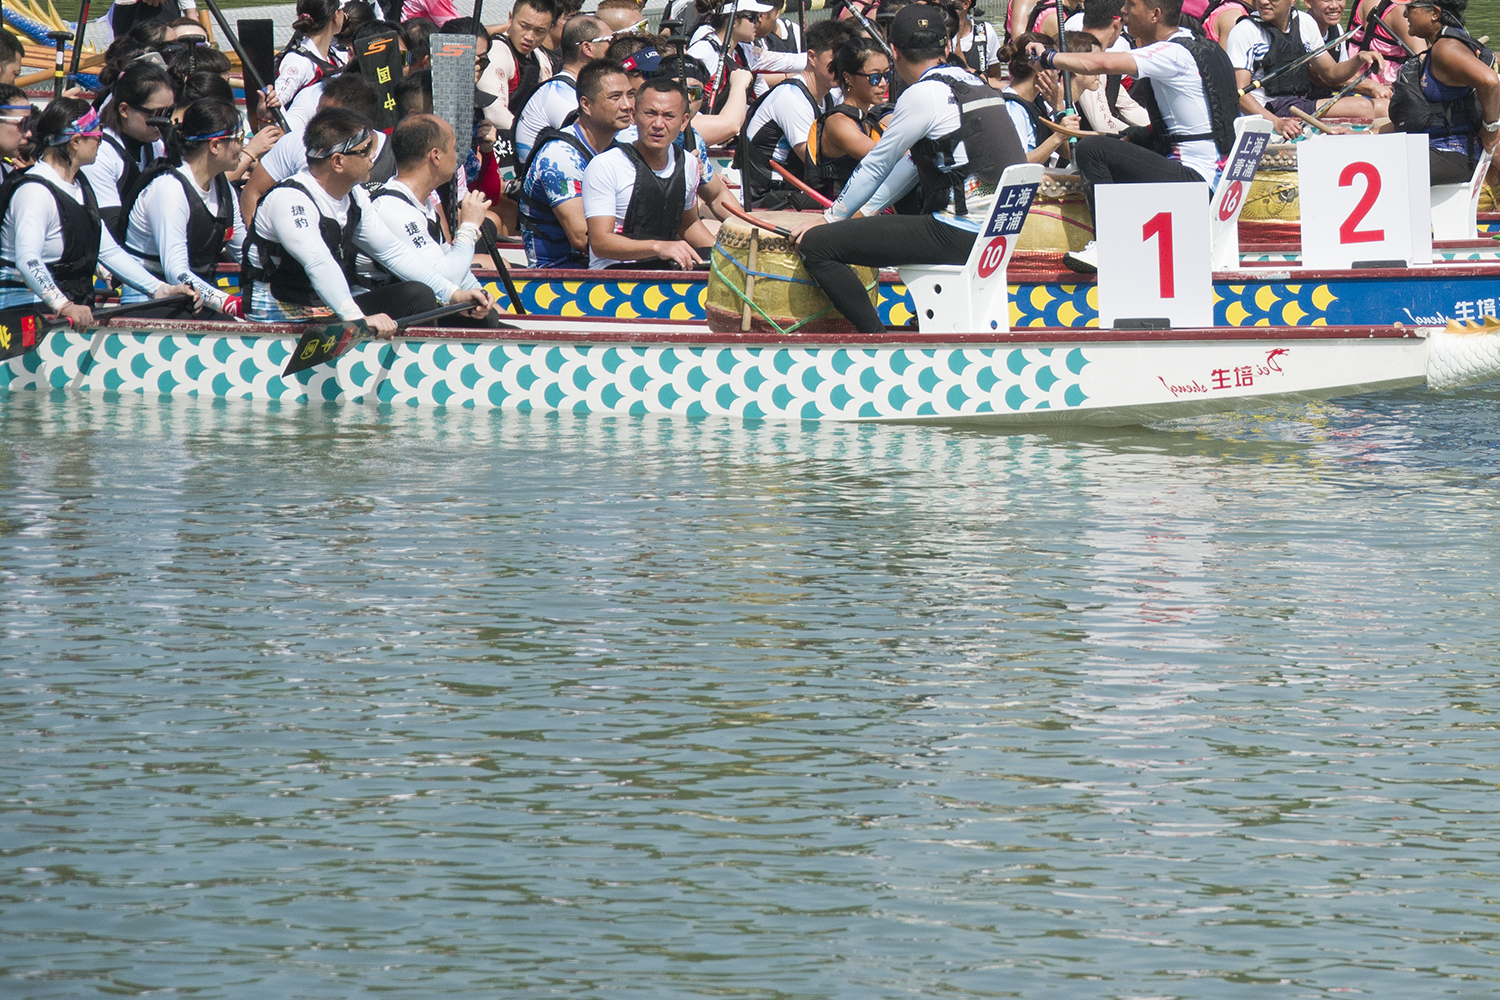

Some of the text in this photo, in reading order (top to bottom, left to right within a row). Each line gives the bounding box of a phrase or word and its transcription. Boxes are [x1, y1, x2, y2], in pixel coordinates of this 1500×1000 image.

[1240, 136, 1265, 156] 上海
[1000, 187, 1033, 209] 上海
[1222, 190, 1239, 212] 16
[1338, 161, 1385, 245] 2
[291, 205, 309, 229] 捷豹
[992, 211, 1024, 233] 青浦
[405, 221, 427, 249] 捷豹
[982, 245, 1003, 269] 10
[1143, 212, 1175, 298] 1
